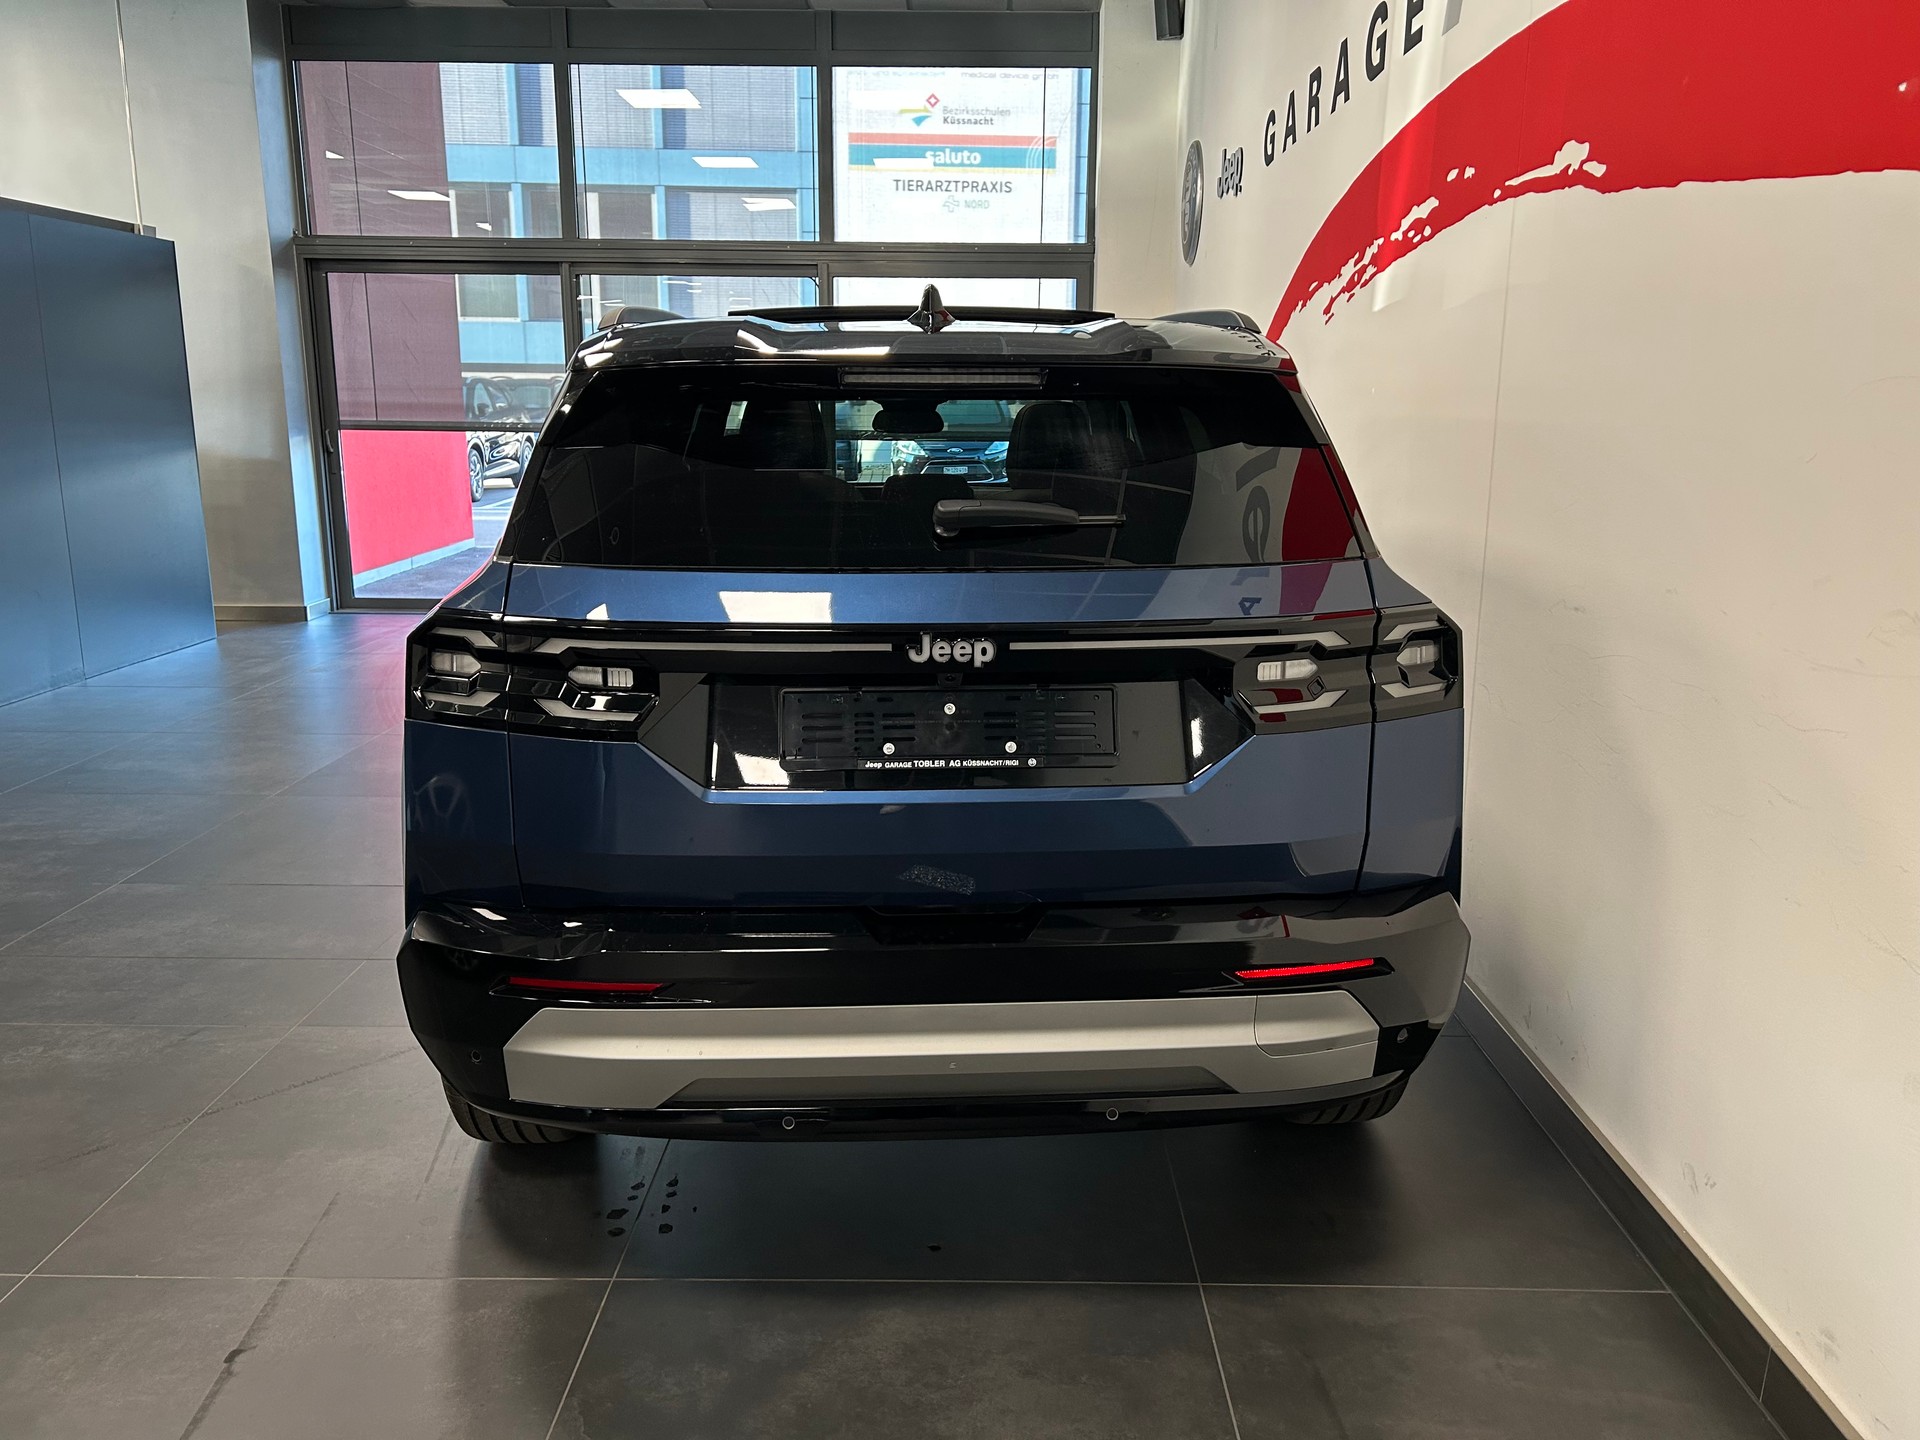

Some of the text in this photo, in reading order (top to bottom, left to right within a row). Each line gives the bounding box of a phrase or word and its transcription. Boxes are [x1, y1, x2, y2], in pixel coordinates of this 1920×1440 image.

[1217, 147, 1243, 199] Jeep
[1263, 0, 1424, 167] GARAGE
[942, 105, 1011, 116] Bezirksschulen
[943, 116, 994, 125] Küssnacht
[925, 148, 982, 165] saluto
[893, 179, 1013, 193] TIERARZTPRAXIS
[964, 199, 990, 209] NORD
[906, 631, 997, 668] Jeep
[865, 761, 883, 769] Jeep
[913, 760, 945, 768] TOBLER
